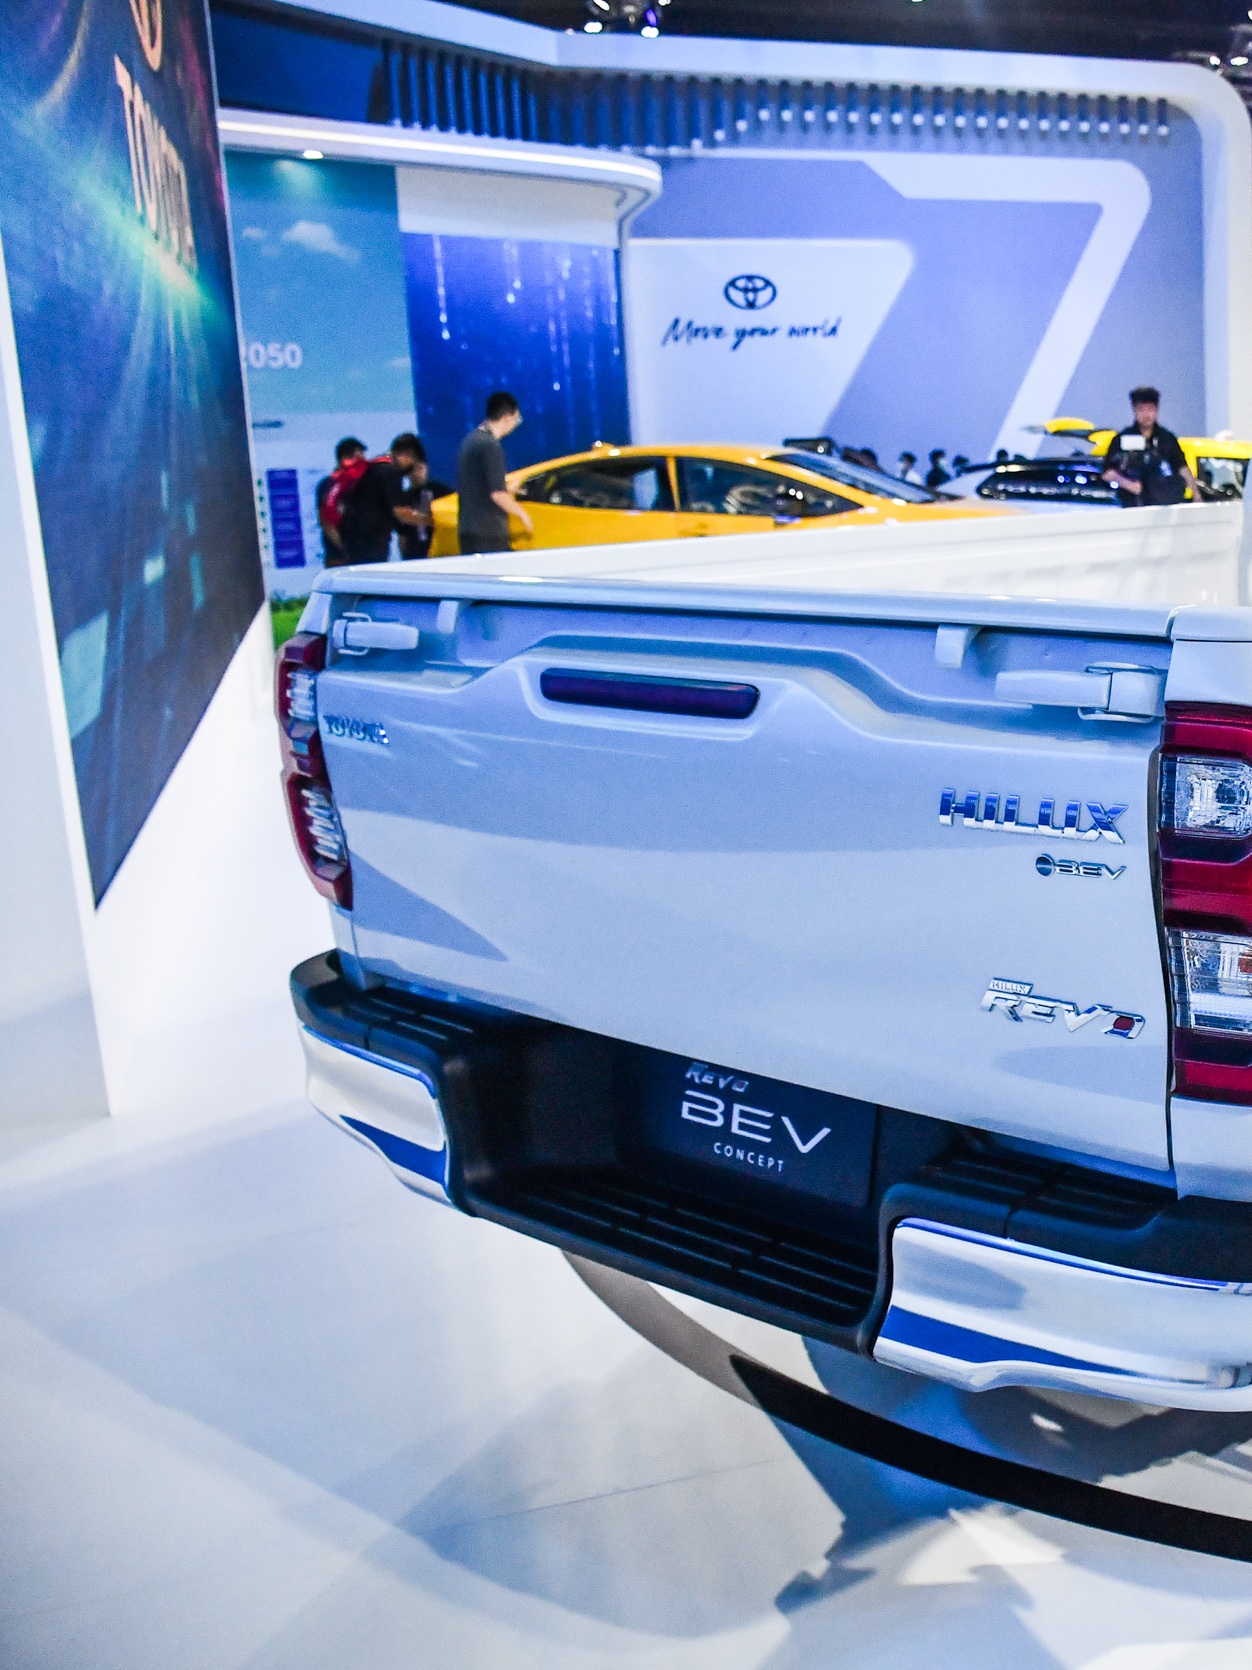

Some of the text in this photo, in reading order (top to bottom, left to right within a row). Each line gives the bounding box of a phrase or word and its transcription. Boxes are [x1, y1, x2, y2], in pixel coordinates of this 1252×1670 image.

[660, 316, 842, 351] Move your world
[939, 787, 1128, 844] HILUX
[1055, 858, 1127, 880] BEV
[992, 979, 1027, 994] HILUX
[979, 990, 1146, 1040] REVO
[681, 1089, 831, 1154] BEV
[713, 1142, 784, 1172] CONCEPT
